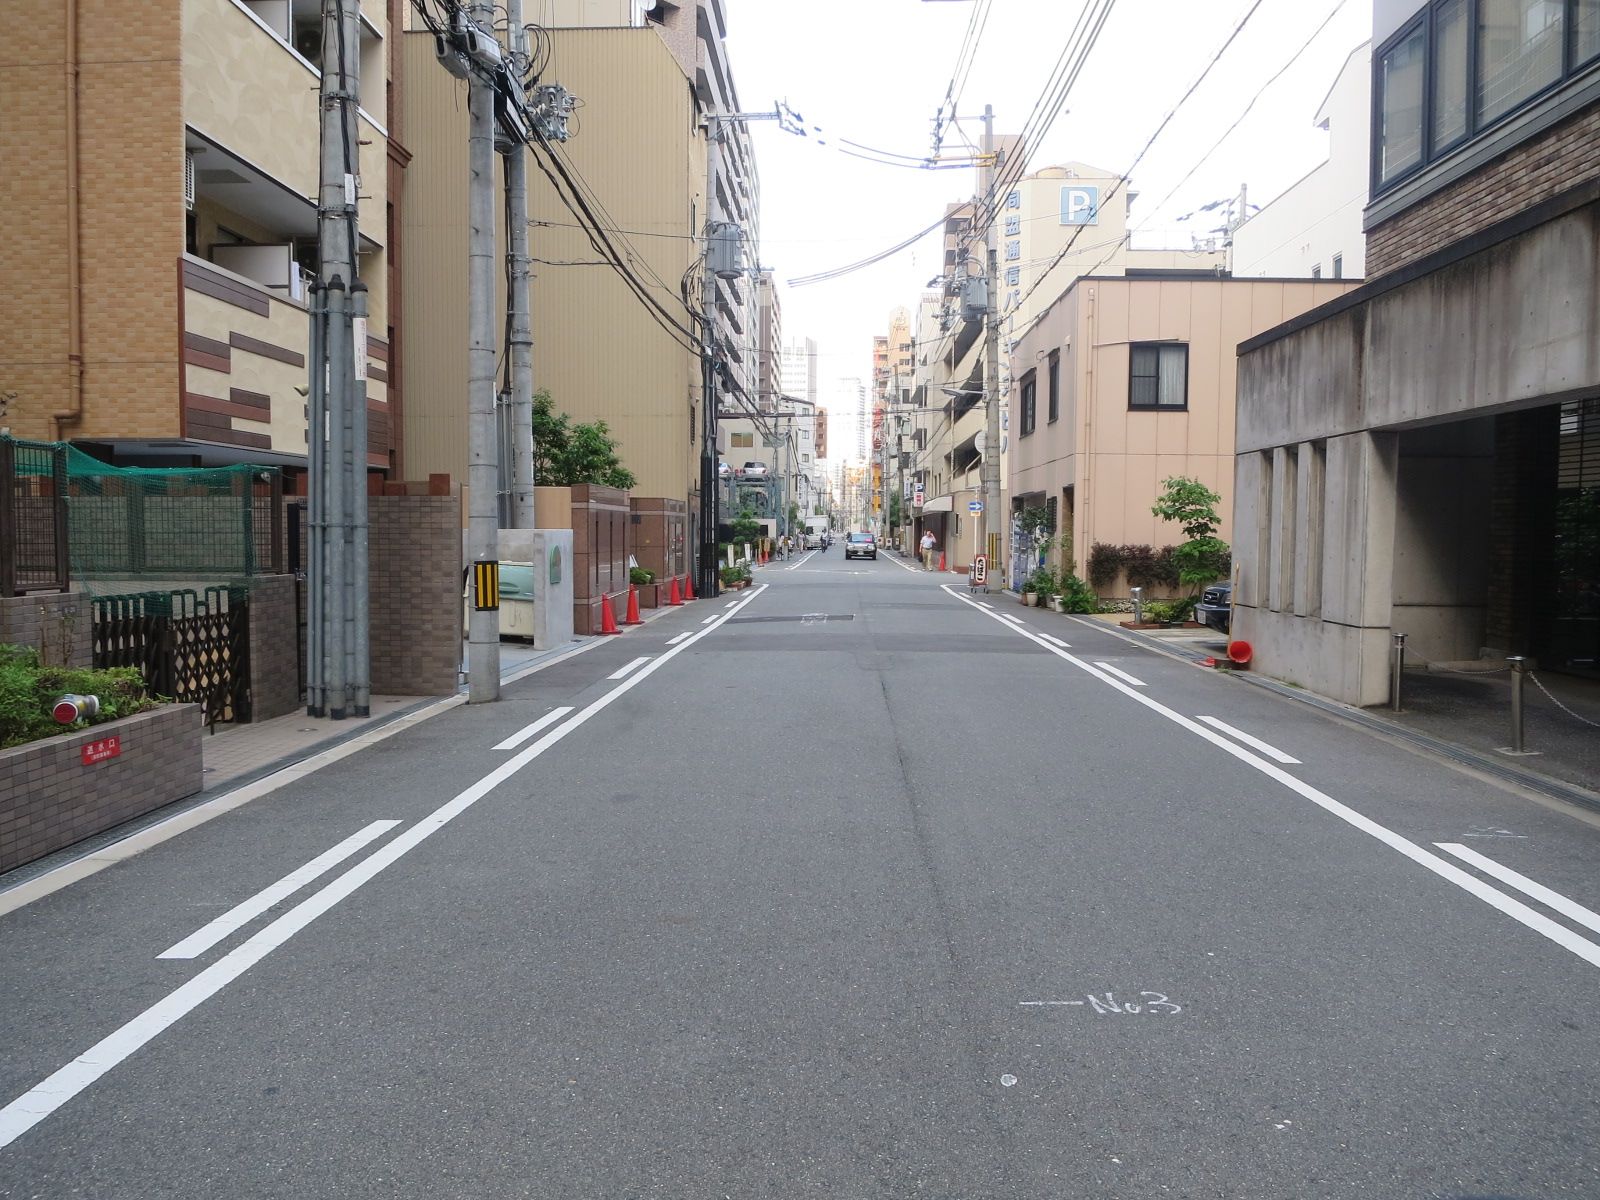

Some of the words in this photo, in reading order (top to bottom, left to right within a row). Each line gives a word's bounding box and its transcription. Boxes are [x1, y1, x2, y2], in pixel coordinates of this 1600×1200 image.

[1068, 190, 1091, 221] P
[915, 484, 923, 492] P
[87, 738, 115, 755] 送水口
